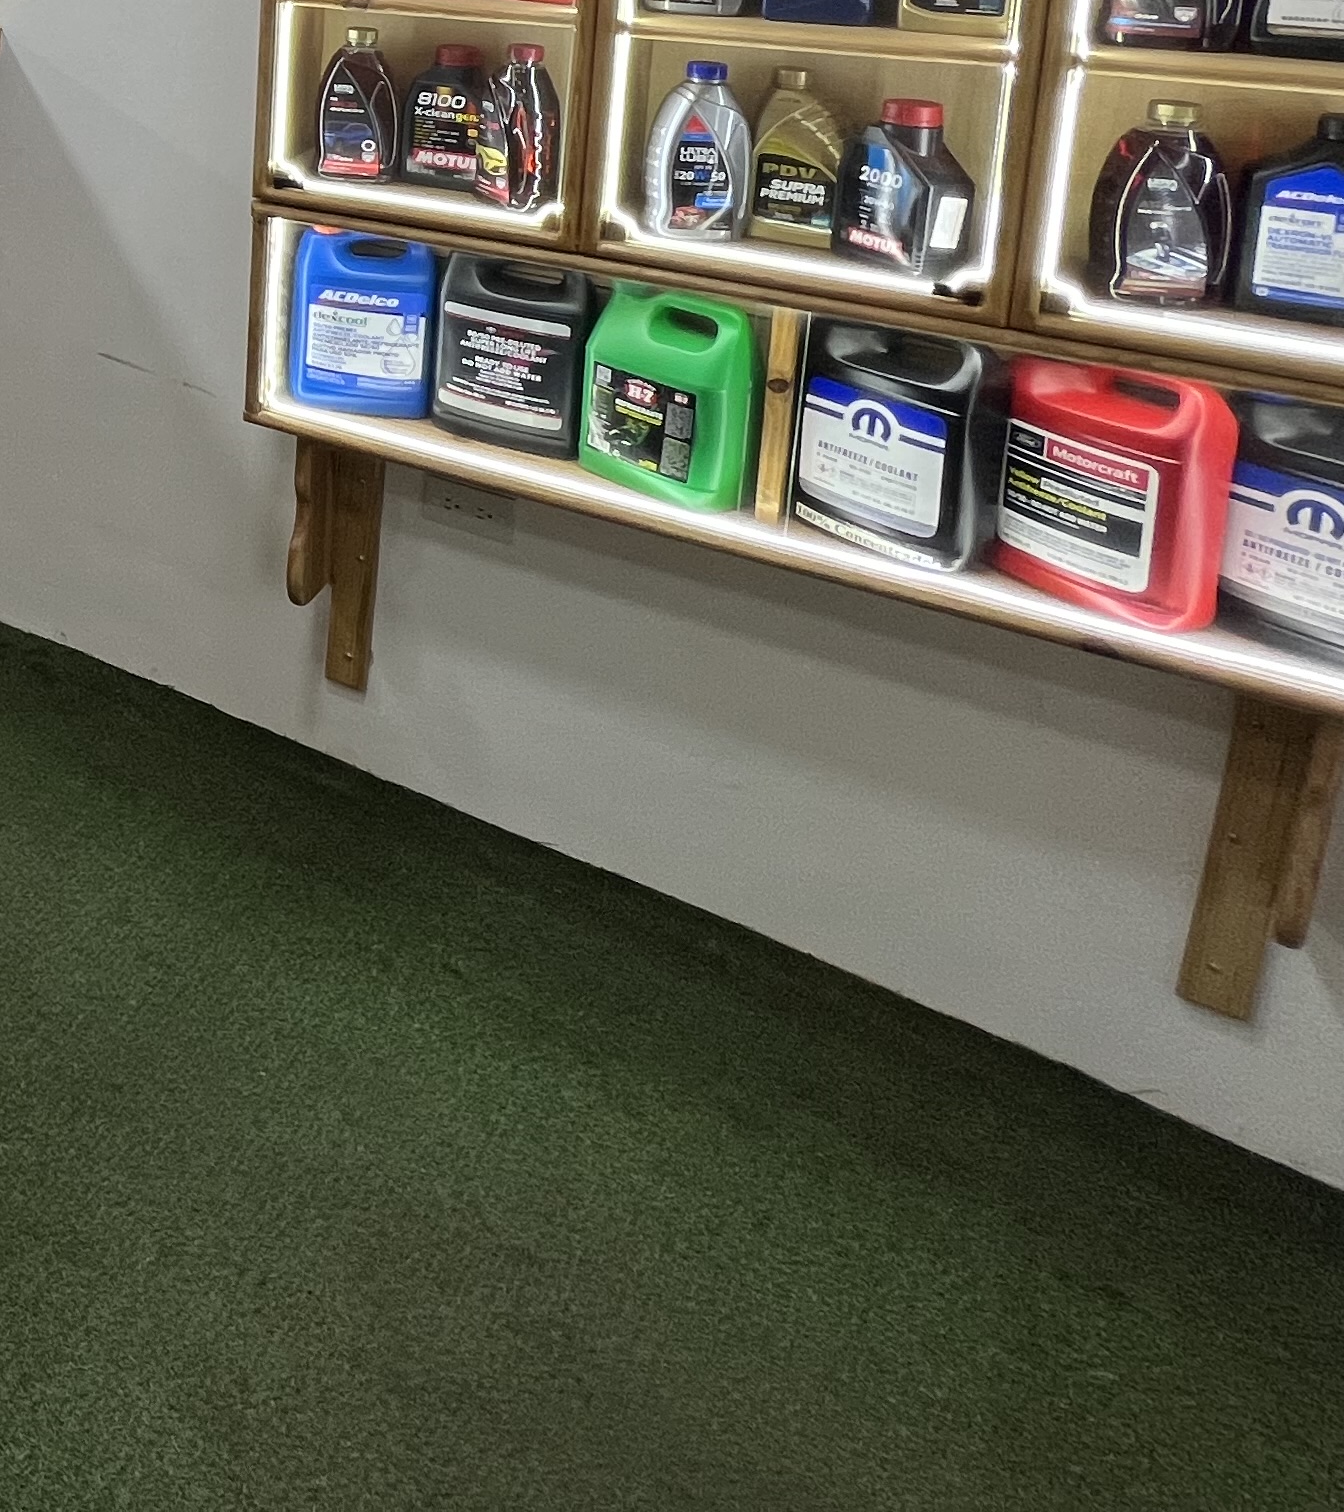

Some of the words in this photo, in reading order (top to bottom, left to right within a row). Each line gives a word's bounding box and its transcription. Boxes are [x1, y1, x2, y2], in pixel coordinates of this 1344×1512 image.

[417, 92, 466, 109] 8100
[762, 163, 818, 178] PDV
[859, 166, 903, 188] 2000
[769, 179, 826, 195] SUPRA
[760, 188, 825, 206] PREMIUM
[318, 289, 400, 308] ACDelco
[513, 372, 542, 382] WATER
[818, 440, 868, 465] ANTIFREEZE
[875, 460, 918, 482] COOLANT
[1053, 445, 1139, 484] Motorcraft
[797, 504, 831, 530] 100%
[1242, 538, 1311, 569] ANTIFREEZE
